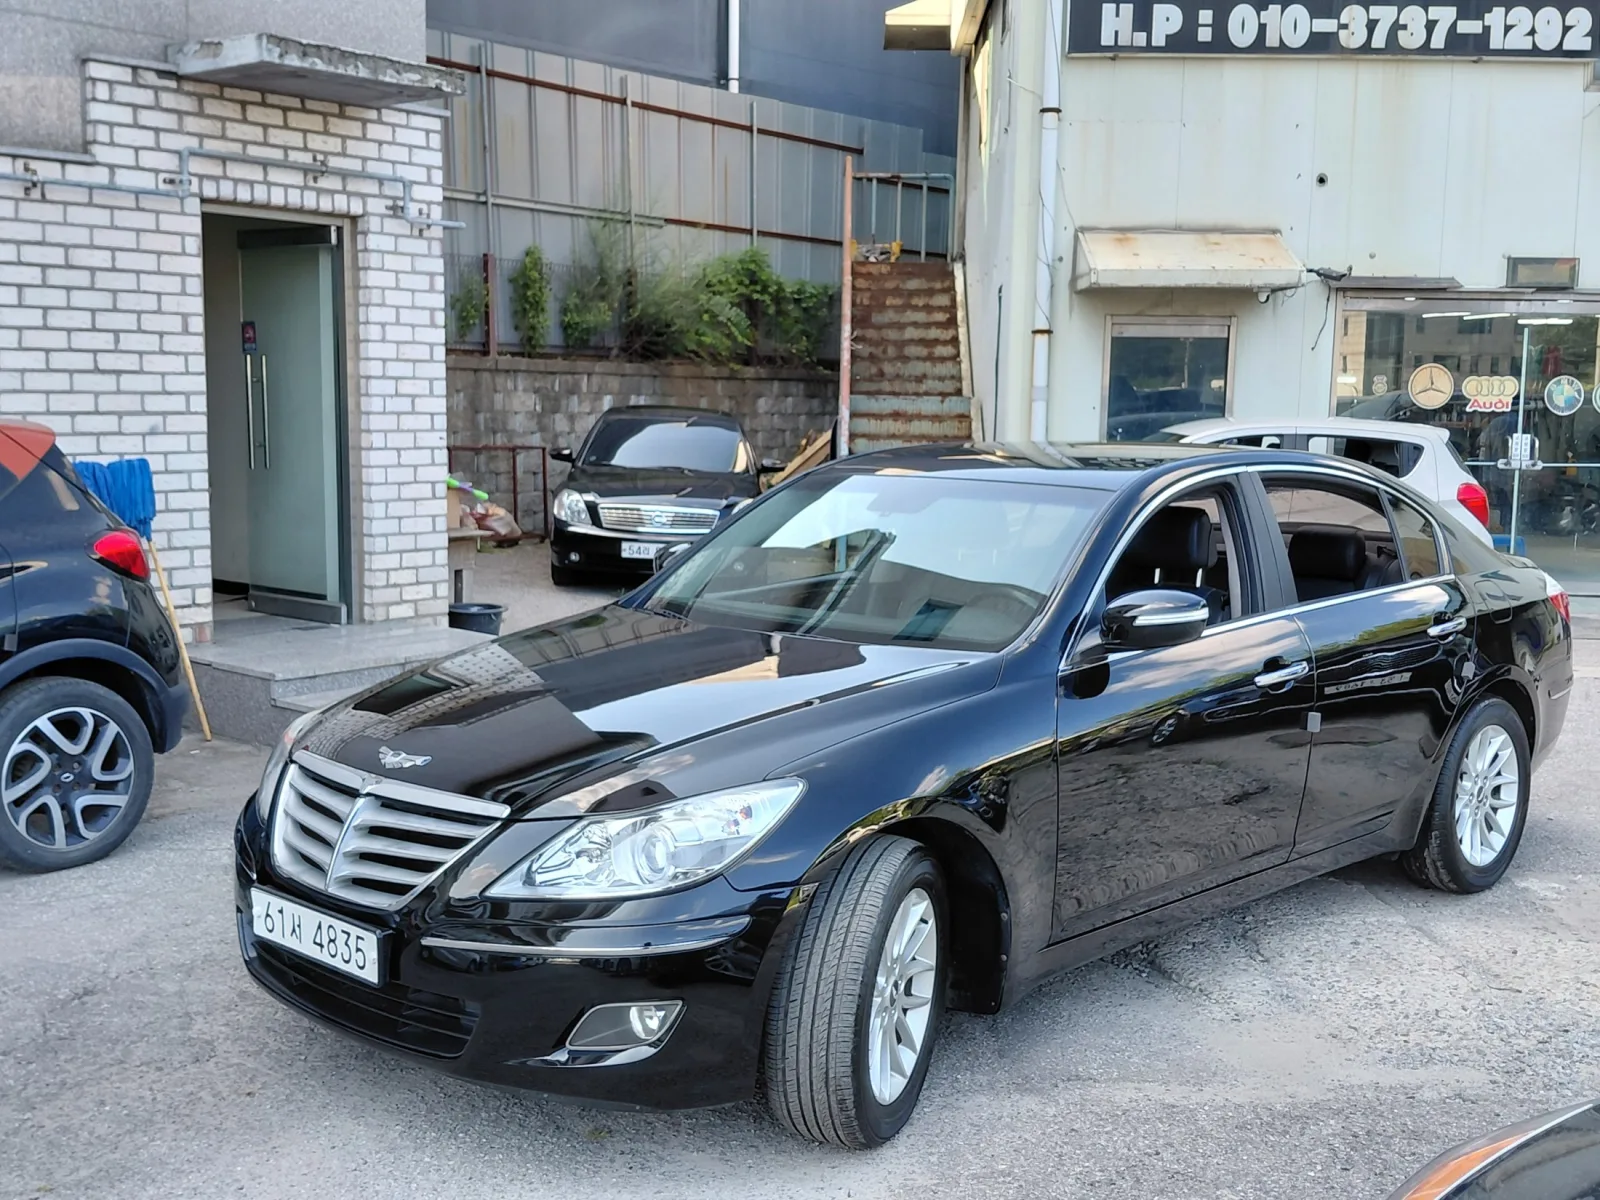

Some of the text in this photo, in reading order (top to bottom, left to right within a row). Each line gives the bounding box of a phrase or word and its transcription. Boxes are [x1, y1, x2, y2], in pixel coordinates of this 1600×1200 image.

[1100, 3, 1183, 47] H.P
[1228, 3, 1593, 51] 010-3737-1292
[1468, 398, 1510, 410] Audi
[264, 901, 366, 970] 61서 4835
